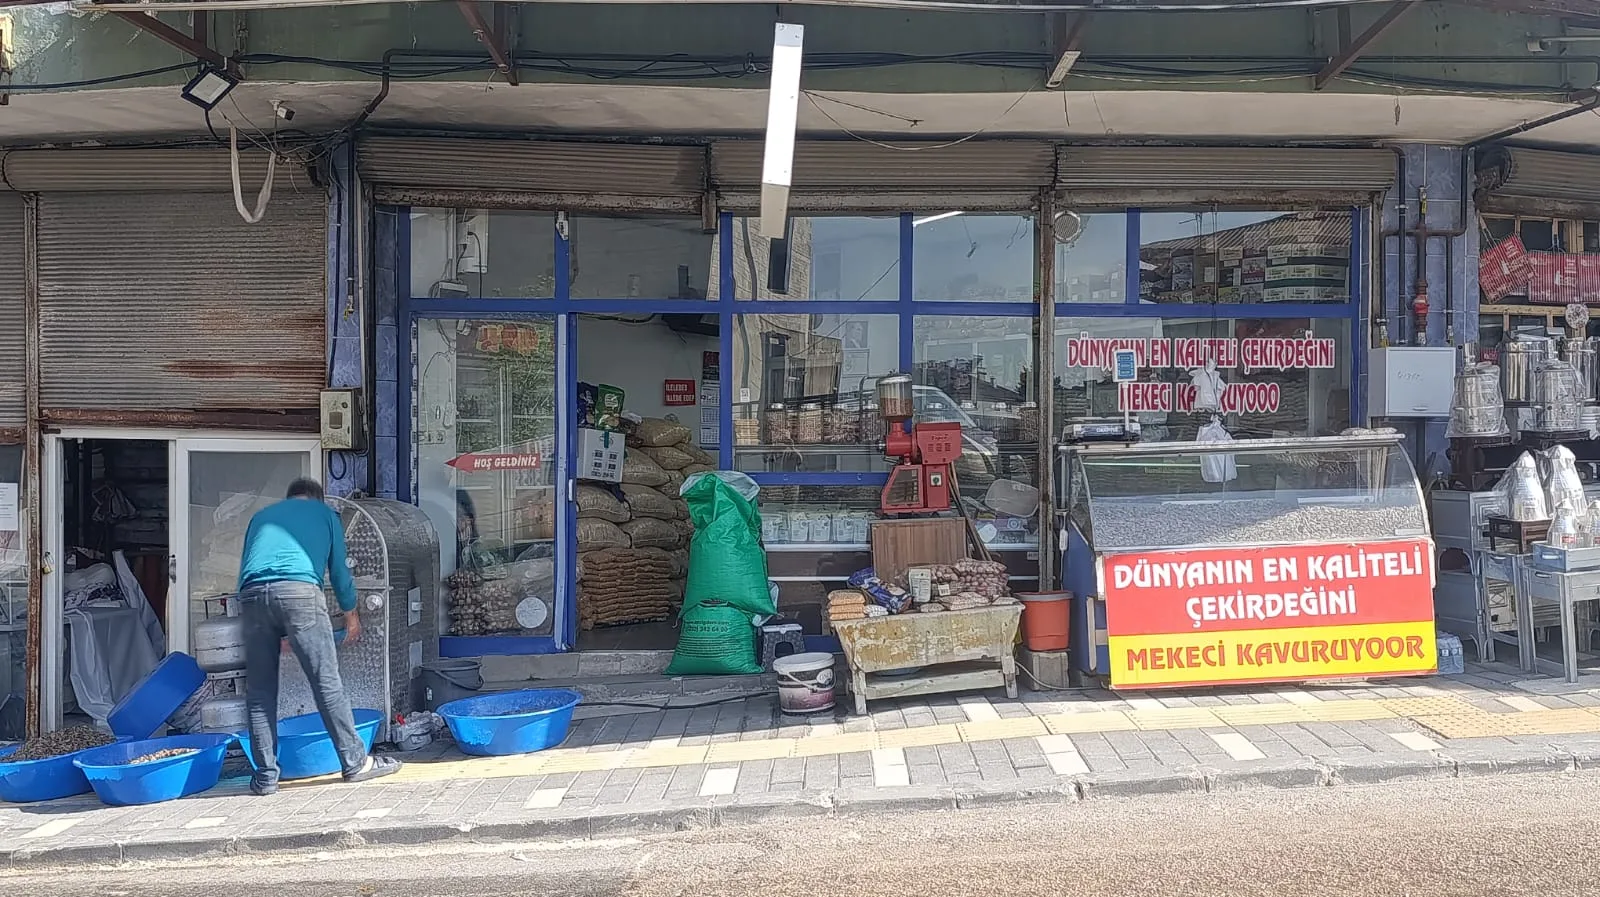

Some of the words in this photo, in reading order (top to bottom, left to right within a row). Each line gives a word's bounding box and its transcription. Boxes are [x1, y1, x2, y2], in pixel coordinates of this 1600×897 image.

[1149, 337, 1171, 368] EN
[474, 457, 492, 470] HOŞ
[494, 454, 537, 468] GELDİNİZ
[1113, 558, 1253, 589] DÜNYANIN
[1262, 557, 1298, 582] EN
[1307, 545, 1423, 581] KALİTELİ
[1186, 584, 1357, 628] ÇEKİRDEĞİNİ
[1127, 640, 1226, 671] MEKECİ
[1237, 635, 1425, 667] KAVURUYOOR
